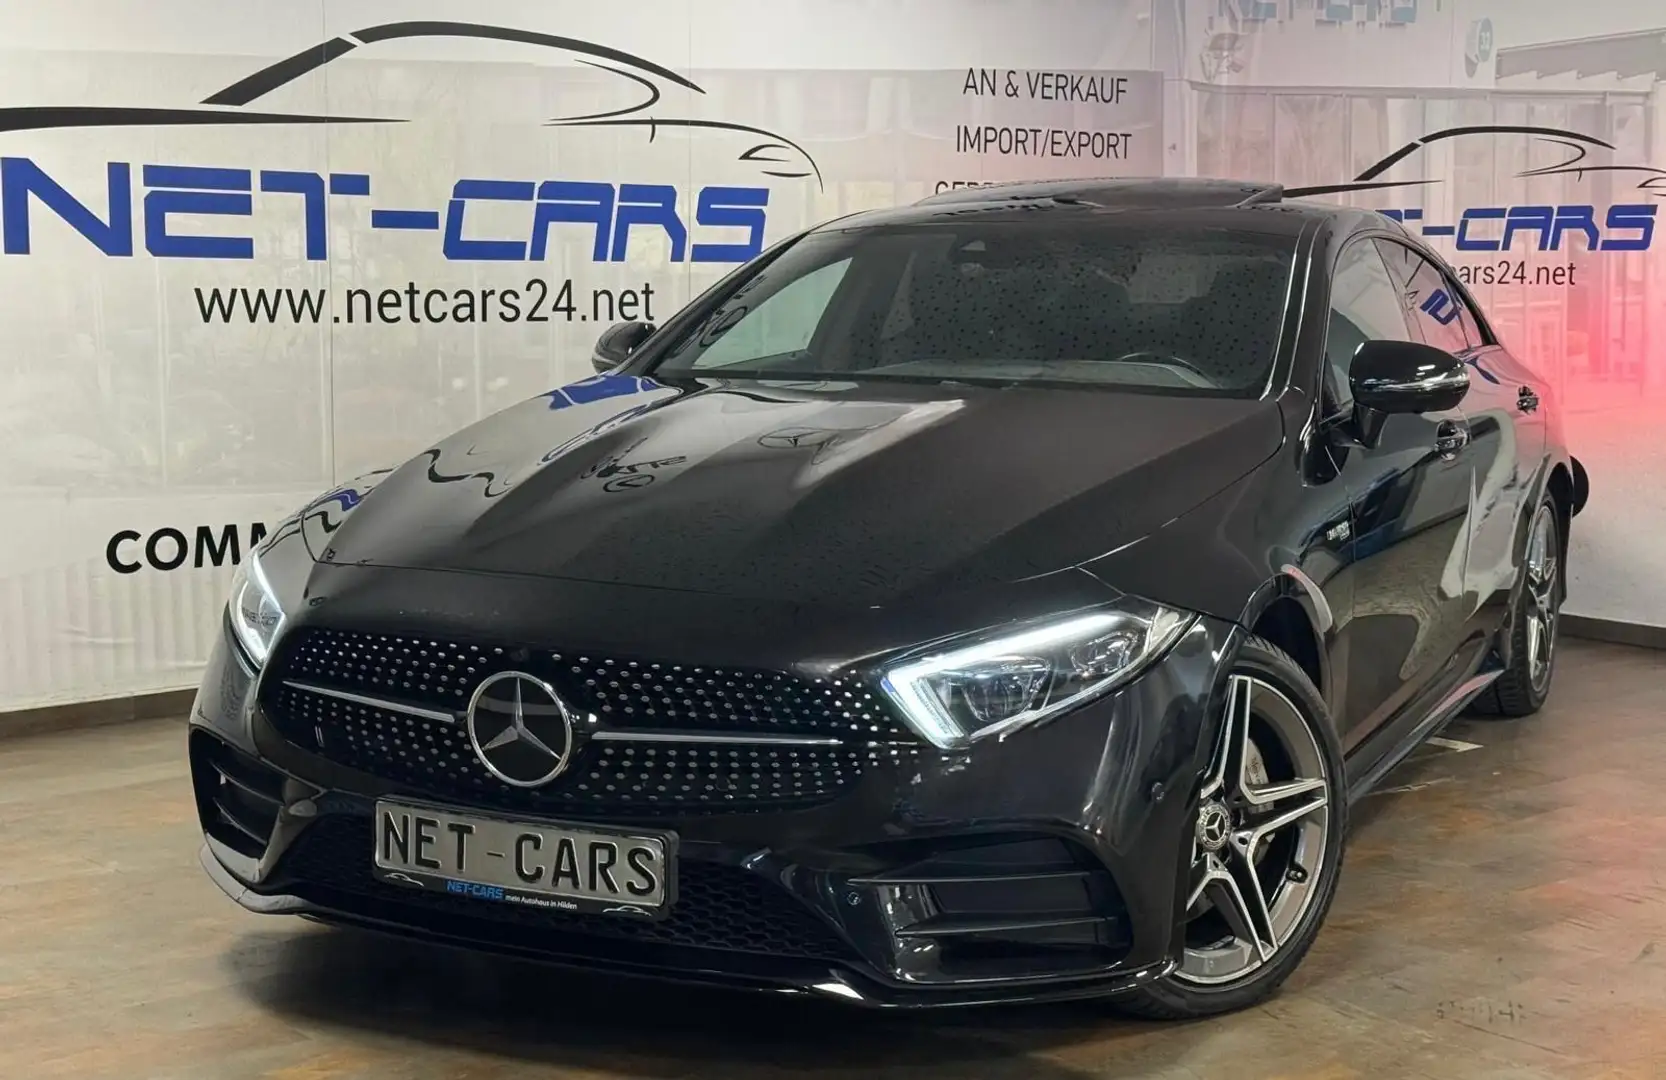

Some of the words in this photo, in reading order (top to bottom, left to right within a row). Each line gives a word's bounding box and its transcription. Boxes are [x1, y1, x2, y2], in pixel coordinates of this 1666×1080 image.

[963, 67, 997, 97] AN
[1004, 69, 1020, 99] &
[1026, 71, 1128, 104] VERKAUF
[956, 125, 1132, 160] IMPORT/EXPORT
[0, 157, 770, 263] NET-CARS
[1452, 261, 1576, 286] ars24.net
[195, 278, 655, 324] www.netcars24.net
[446, 880, 504, 899] NET-CARS
